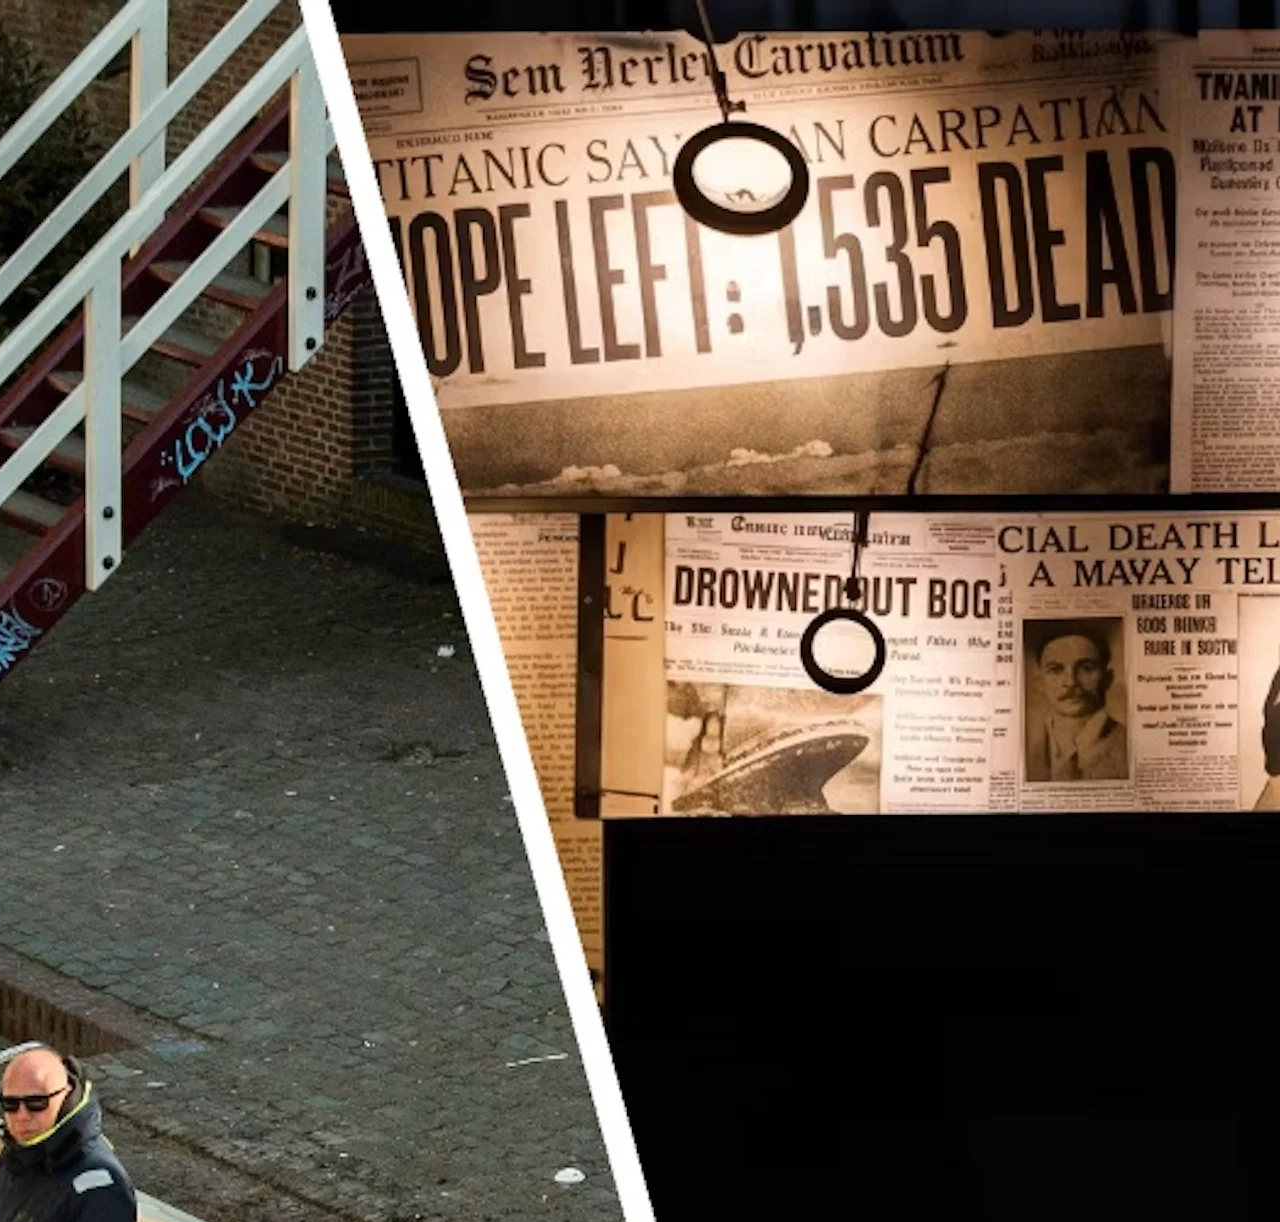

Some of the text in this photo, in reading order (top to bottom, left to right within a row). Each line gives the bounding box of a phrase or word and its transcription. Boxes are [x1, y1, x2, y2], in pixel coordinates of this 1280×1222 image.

[977, 147, 1177, 329] DEAD
[997, 524, 1089, 553] CIAL
[1108, 521, 1239, 551] DEATH
[1028, 560, 1056, 587] A
[927, 578, 992, 620] BOG
